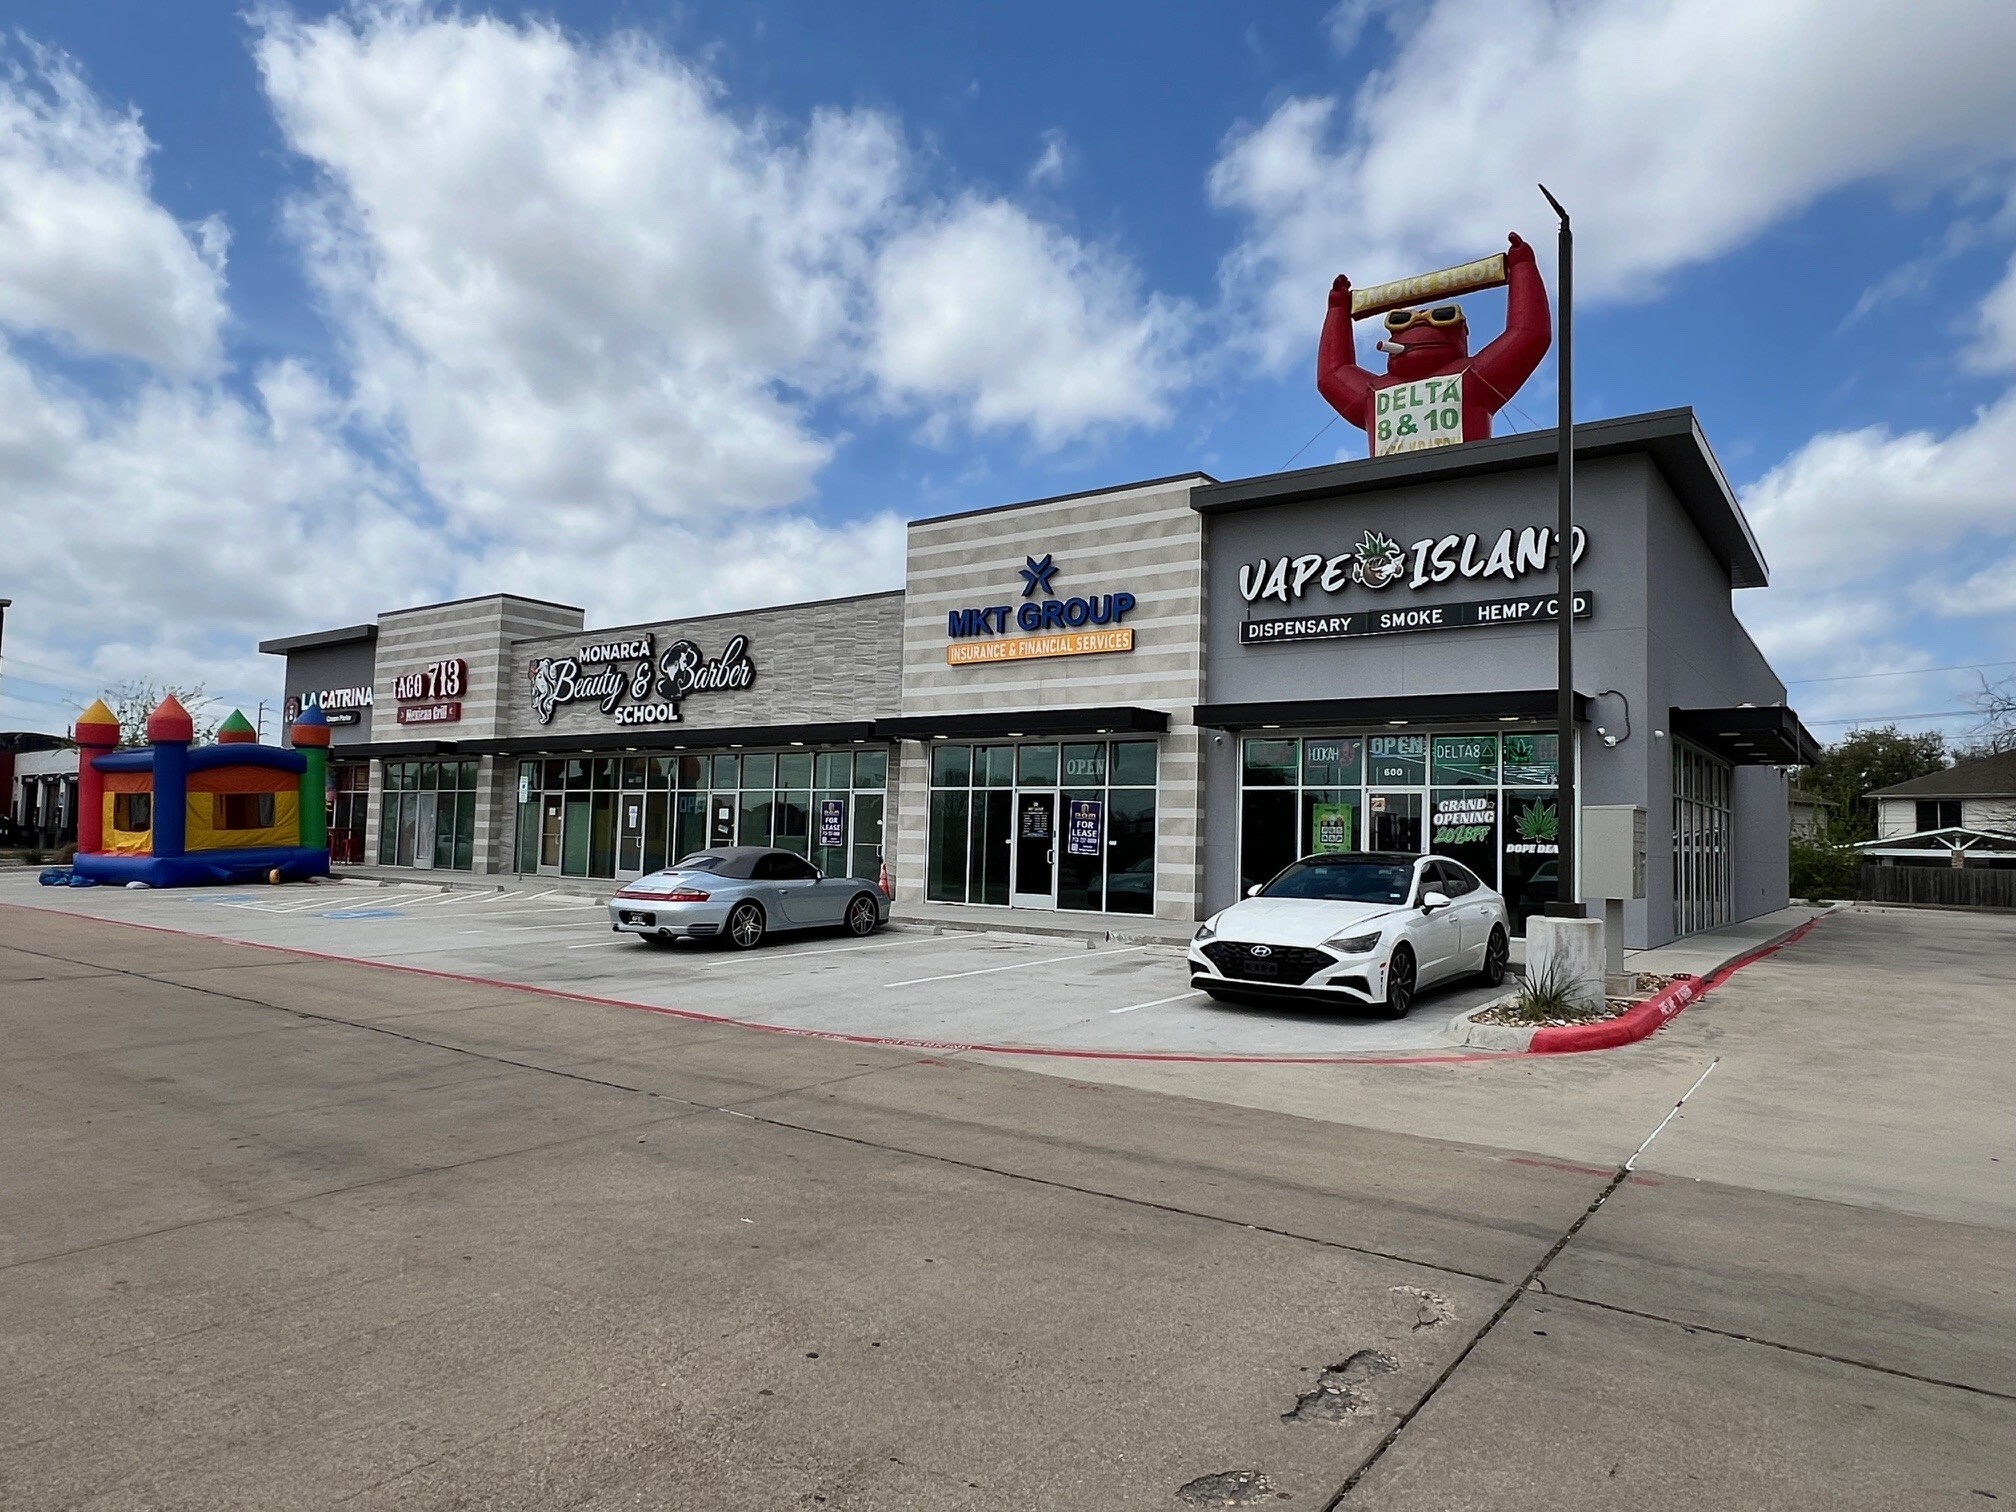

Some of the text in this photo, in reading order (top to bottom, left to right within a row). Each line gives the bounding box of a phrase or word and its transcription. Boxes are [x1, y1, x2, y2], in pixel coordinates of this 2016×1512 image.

[1377, 378, 1462, 416] DELTA
[1377, 408, 1459, 441] 8 & 10
[1238, 554, 1352, 602] VAPE
[948, 592, 1136, 637] MKT GROUP
[1248, 597, 1586, 639] DISPENSARY SMOKE HEMP/CD
[579, 641, 650, 663] MONARCA
[950, 632, 1131, 661] INSURANCE & FINANCIAL SERVICES
[391, 660, 460, 699] TACO 713
[552, 635, 752, 711] Beauty & Barber
[300, 686, 374, 711] LA CATRINA
[405, 705, 448, 721] Mexican Grill
[614, 704, 678, 724] SCHOOL
[1308, 747, 1339, 761] HOOKAH
[1370, 736, 1424, 755] OPEN
[1436, 744, 1481, 759] DELTA8
[1067, 759, 1105, 775] OPEN
[1383, 768, 1403, 777] 600
[1439, 798, 1487, 812] GRAND
[1076, 821, 1095, 829] FOR
[1433, 811, 1496, 826] OPENING
[1072, 829, 1097, 838] LEASE
[1506, 843, 1560, 854] DOPE DEA
